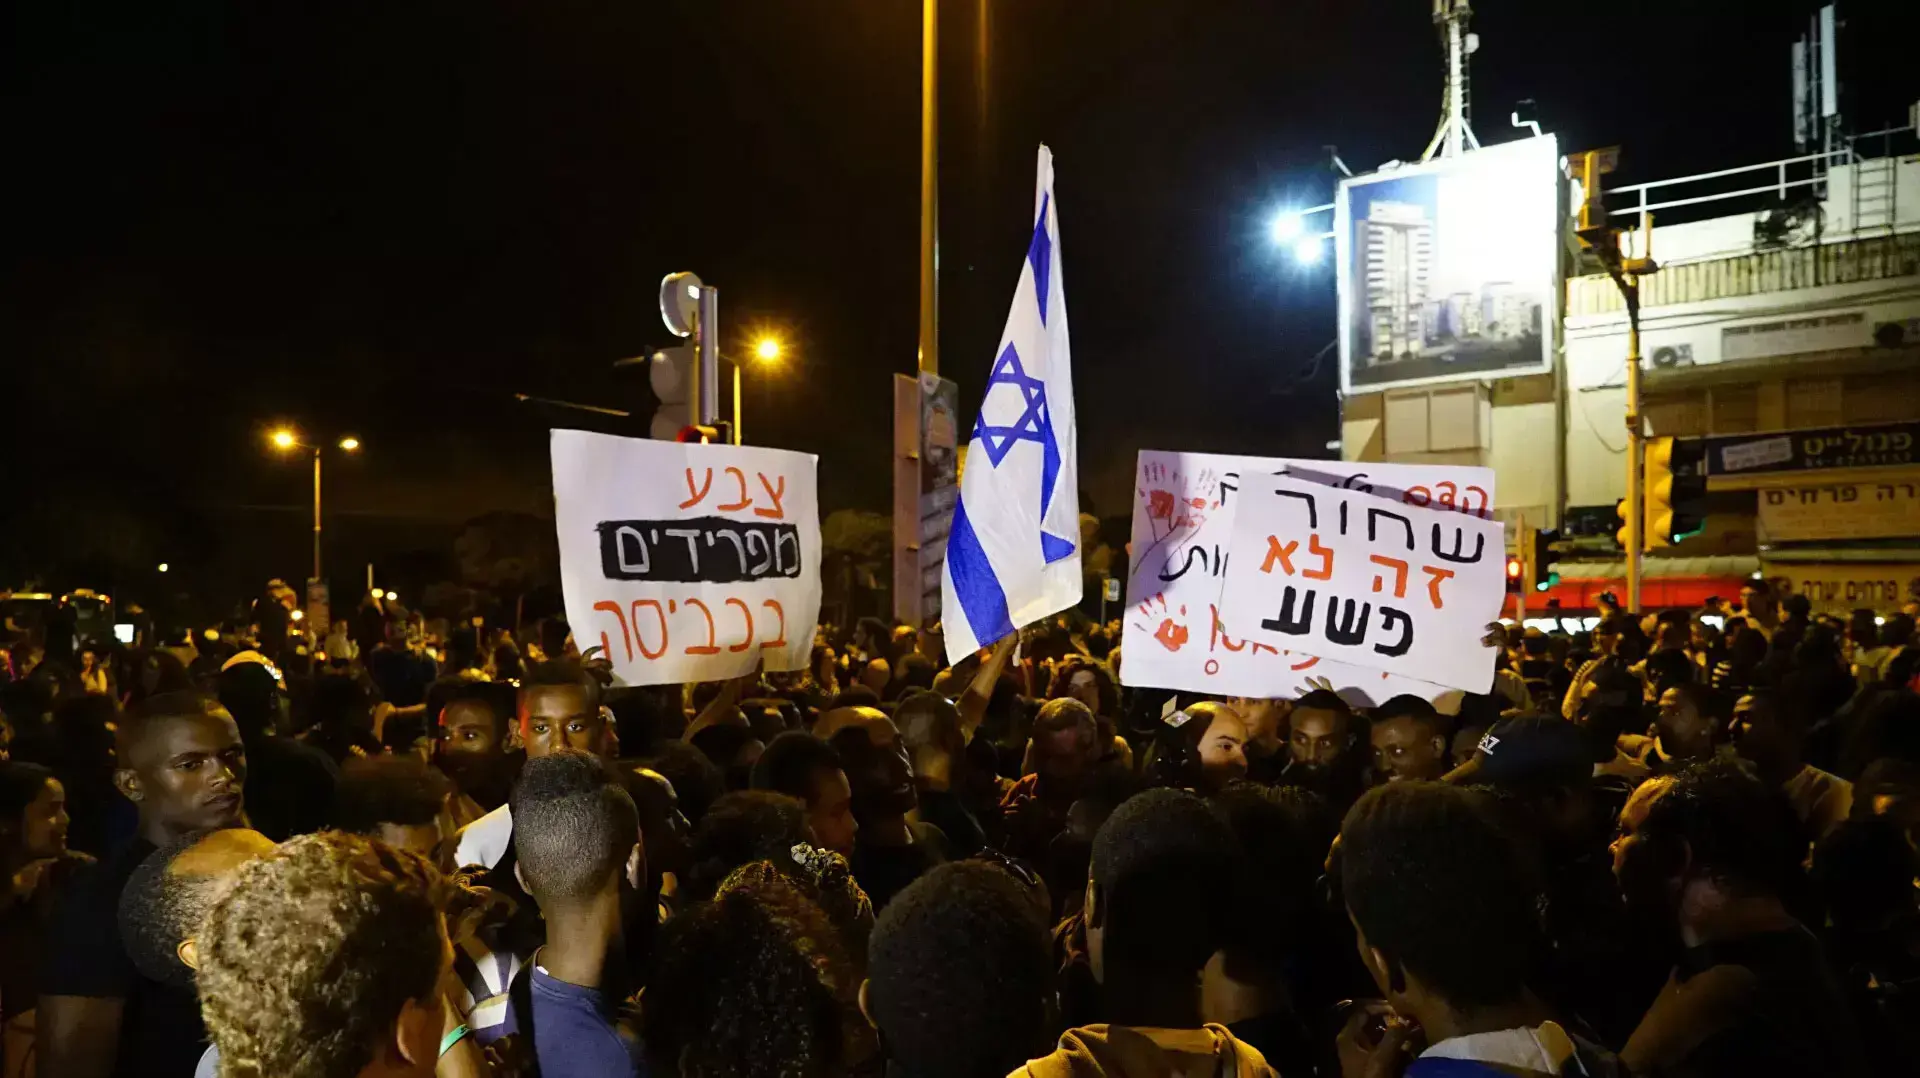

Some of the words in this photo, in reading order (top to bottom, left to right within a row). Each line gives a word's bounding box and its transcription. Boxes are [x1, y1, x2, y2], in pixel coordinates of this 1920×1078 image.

[678, 466, 785, 519] צבע
[1766, 486, 1858, 506] פרחים
[615, 525, 799, 576] מפרידים
[1274, 488, 1485, 564] שחור
[1259, 533, 1334, 581] לא
[1369, 553, 1455, 609] זה
[593, 597, 788, 663] בכביסה
[1260, 585, 1414, 658] פשע
